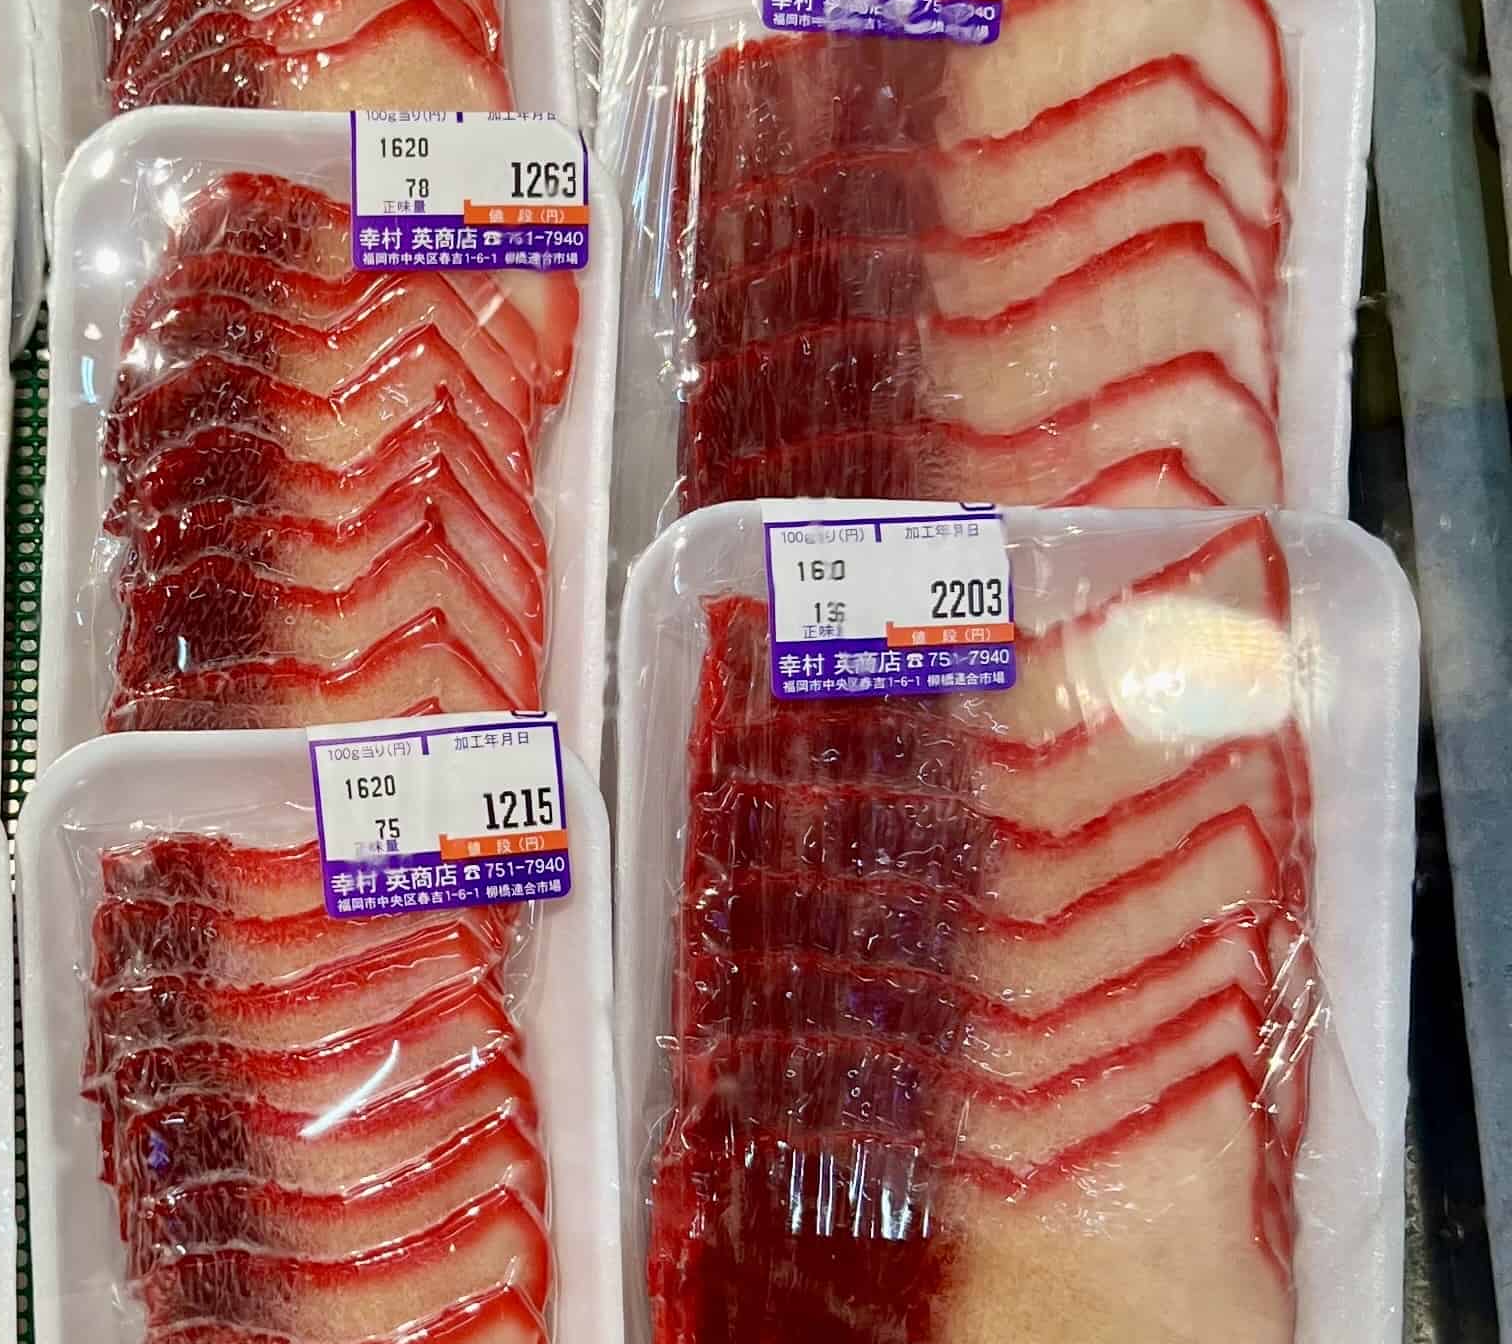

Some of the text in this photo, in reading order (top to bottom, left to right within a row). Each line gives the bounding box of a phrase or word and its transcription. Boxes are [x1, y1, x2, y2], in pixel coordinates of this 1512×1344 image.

[380, 137, 429, 158] 1620
[406, 178, 430, 198] 78
[511, 161, 577, 198] 1263
[359, 227, 402, 250] 幸村
[412, 227, 478, 250] 英商店
[930, 578, 1002, 619] 2203
[778, 650, 901, 676] 幸村 英商店
[453, 731, 529, 751] 加工年月日
[345, 774, 396, 800] 1620
[483, 786, 553, 830] 1215
[375, 818, 400, 839] 75
[331, 856, 565, 896] 幸村 英商店 751-7940
